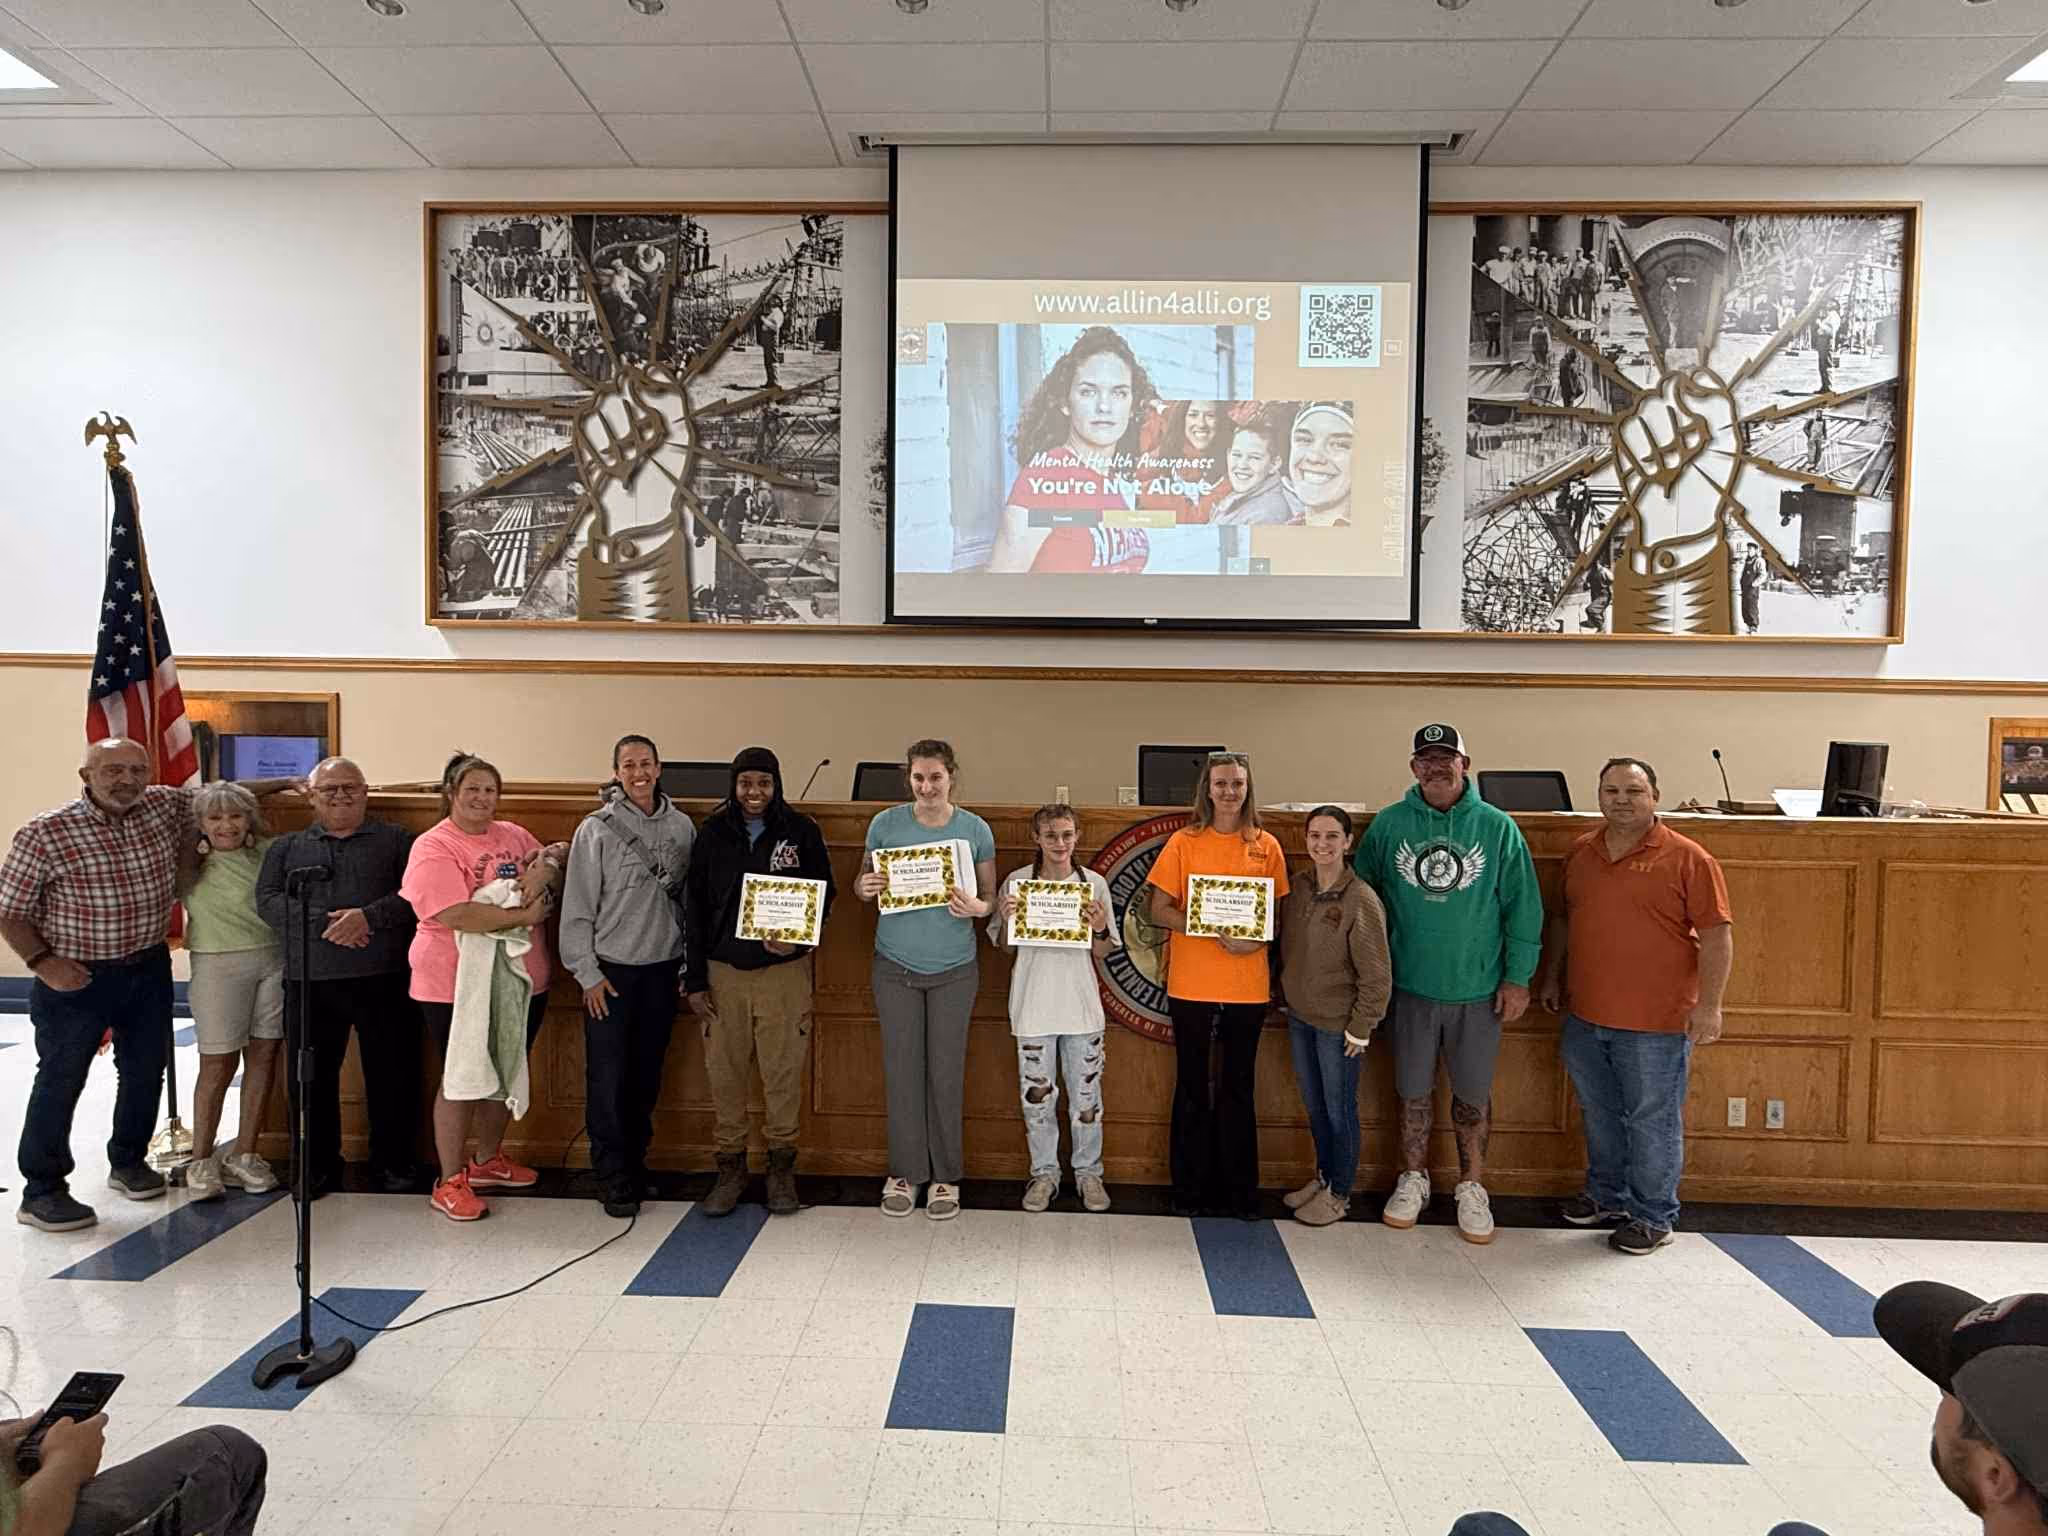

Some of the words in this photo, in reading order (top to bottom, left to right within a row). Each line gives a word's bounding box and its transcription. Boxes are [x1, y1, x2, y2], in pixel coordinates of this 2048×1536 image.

[1034, 290, 1272, 321] www.allin4alli.org
[1029, 452, 1081, 468] Mental
[1084, 451, 1133, 469] Health
[1137, 452, 1215, 469] Awareness
[1028, 477, 1097, 495] You're
[1103, 478, 1142, 496] Nt
[1030, 901, 1078, 909] SCHOLARSHIP
[1205, 897, 1254, 906] SCHOLARSHIP
